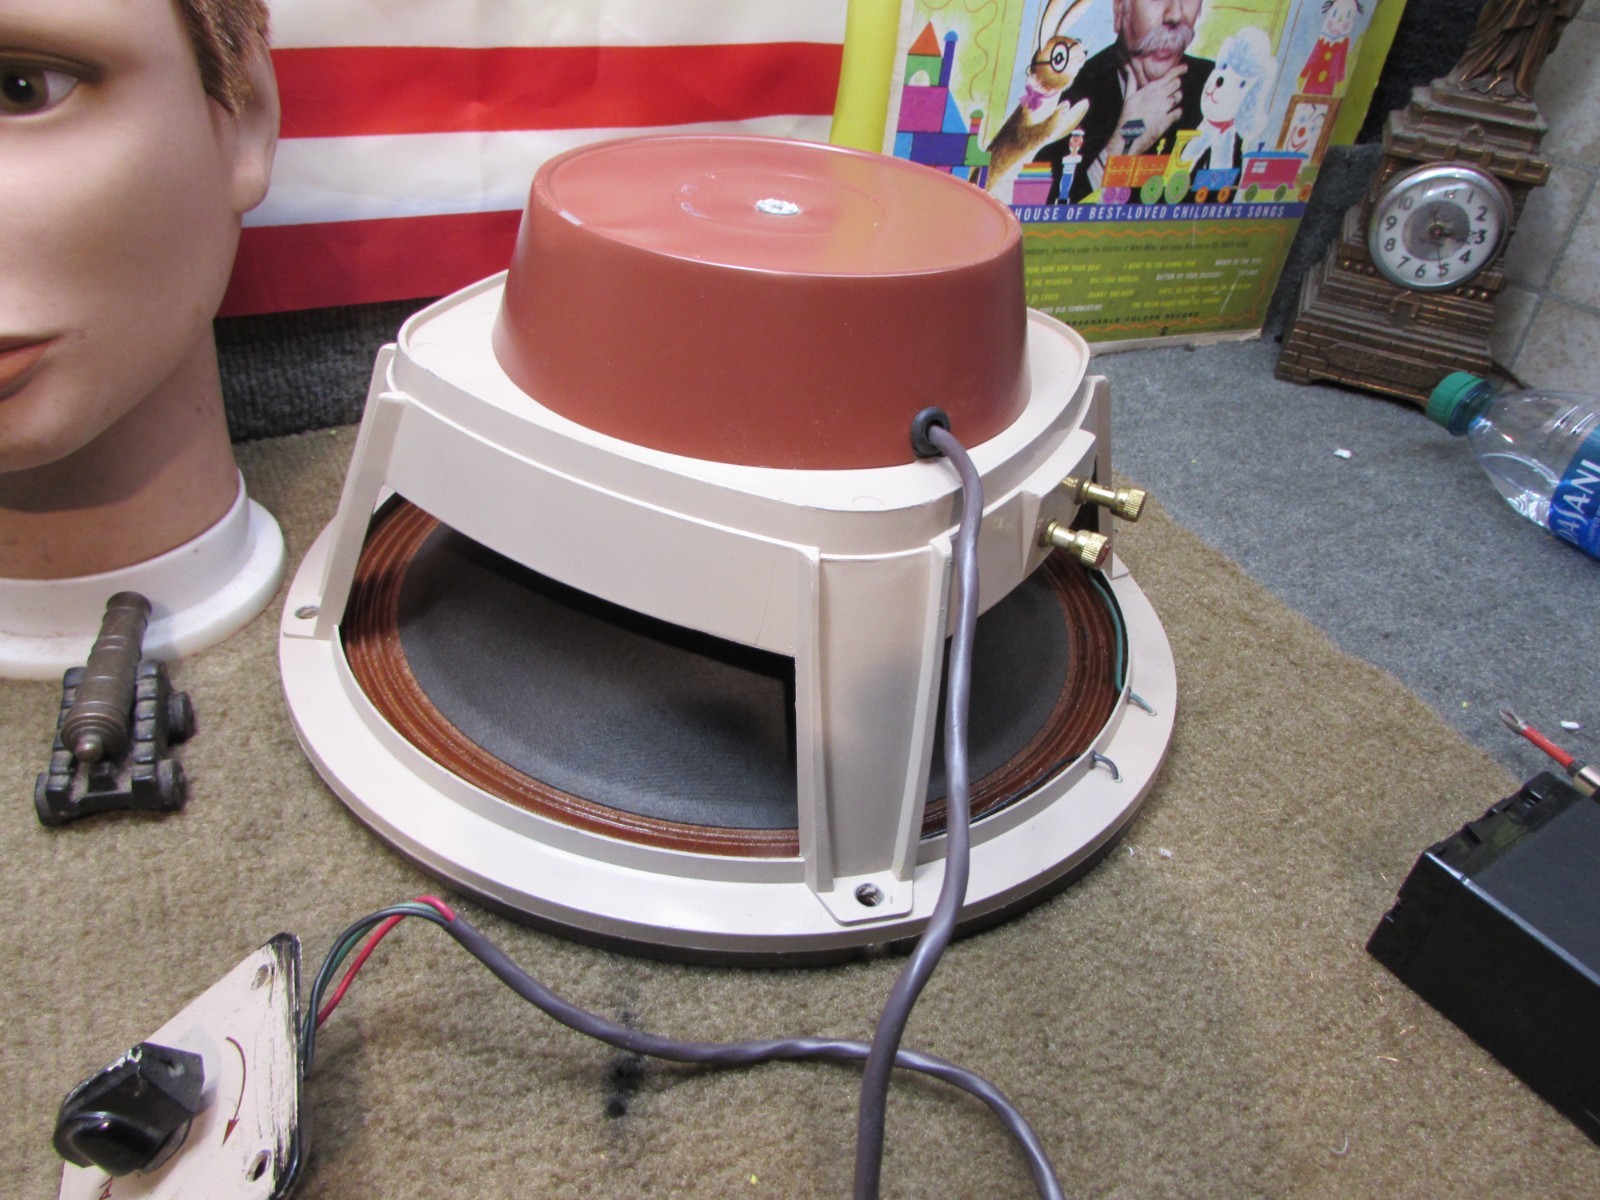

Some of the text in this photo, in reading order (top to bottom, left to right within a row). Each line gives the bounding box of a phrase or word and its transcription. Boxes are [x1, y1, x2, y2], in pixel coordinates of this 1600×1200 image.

[1398, 196, 1414, 211] 10
[1014, 205, 1285, 221] HOUSE OF BEST-LOVED CHILDREN'S SONGS
[1475, 205, 1488, 221] 2
[1385, 215, 1397, 231] 9
[1384, 237, 1396, 252] 8
[1474, 229, 1487, 245] 3
[1396, 256, 1412, 269] 7
[1459, 250, 1472, 264] 4
[1415, 264, 1426, 278] 6
[1438, 263, 1450, 277] 5
[1553, 459, 1600, 546] DASANI
